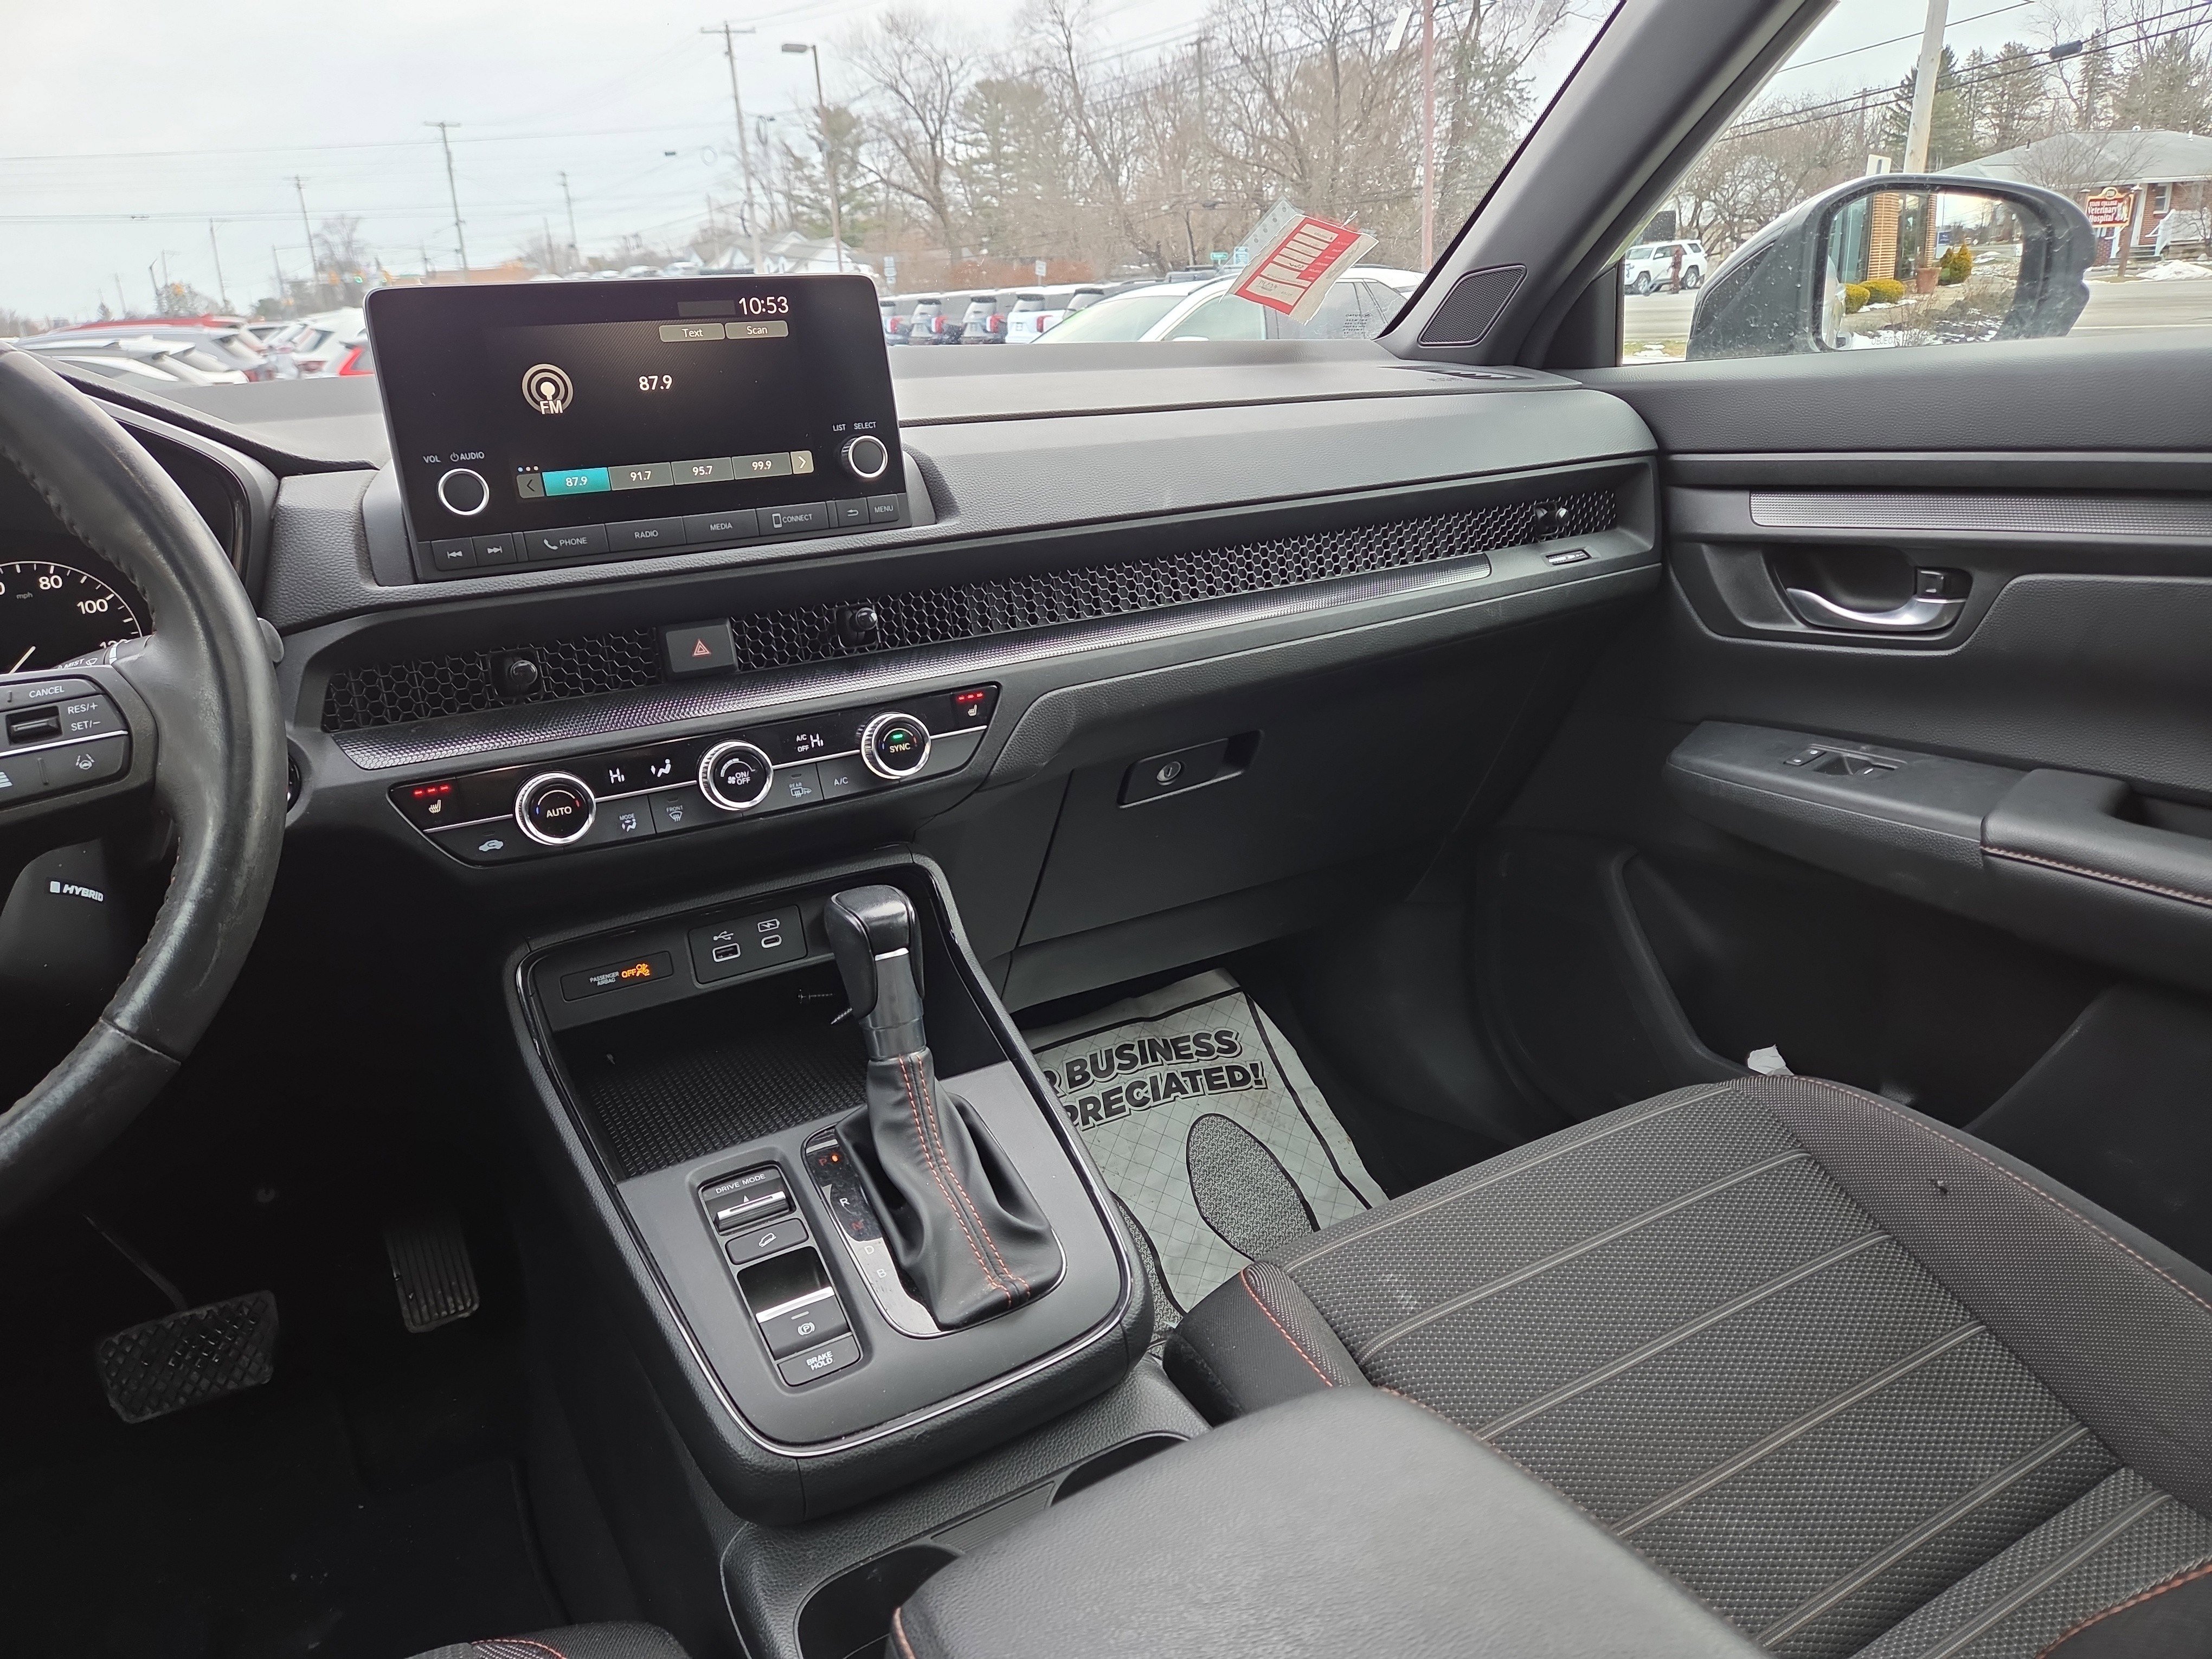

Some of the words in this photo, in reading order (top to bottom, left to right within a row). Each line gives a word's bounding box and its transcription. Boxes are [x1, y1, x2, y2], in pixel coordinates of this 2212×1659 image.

[738, 296, 789, 316] 10:53
[681, 327, 704, 338] Text
[746, 325, 768, 336] Scan
[639, 375, 672, 391] 87.9
[539, 400, 563, 415] FM
[832, 423, 846, 432] LIST
[853, 421, 877, 430] SELECT
[423, 455, 441, 464] VOL
[460, 452, 485, 461] AUDIO
[692, 465, 713, 476] 95.7
[751, 460, 772, 471] 99.9
[565, 476, 588, 488] 87.9
[630, 471, 652, 482] 91.7
[873, 505, 893, 514] MENU
[782, 513, 813, 523] CONNECT
[709, 522, 733, 531] MEDIA
[634, 529, 659, 539] RADIO
[559, 536, 588, 546] PHONE
[38, 575, 63, 590] 80
[16, 591, 33, 600] mph
[76, 599, 108, 615] 100
[29, 685, 65, 699] CANCEL
[797, 744, 809, 753] OFF
[889, 742, 911, 753] SYNC
[736, 776, 751, 785] OFF
[834, 776, 848, 786] A/C
[545, 806, 573, 818] AUTO
[62, 884, 104, 903] HYBRID
[589, 971, 620, 983] PASSENGER
[621, 968, 636, 978] OFF
[1065, 1030, 1242, 1092] BUSINESS
[715, 1181, 741, 1194] DRIVE
[741, 1173, 766, 1186] MODE
[839, 1198, 851, 1207] R
[806, 1351, 833, 1366] BRAKE
[810, 1357, 833, 1371] HOLD
